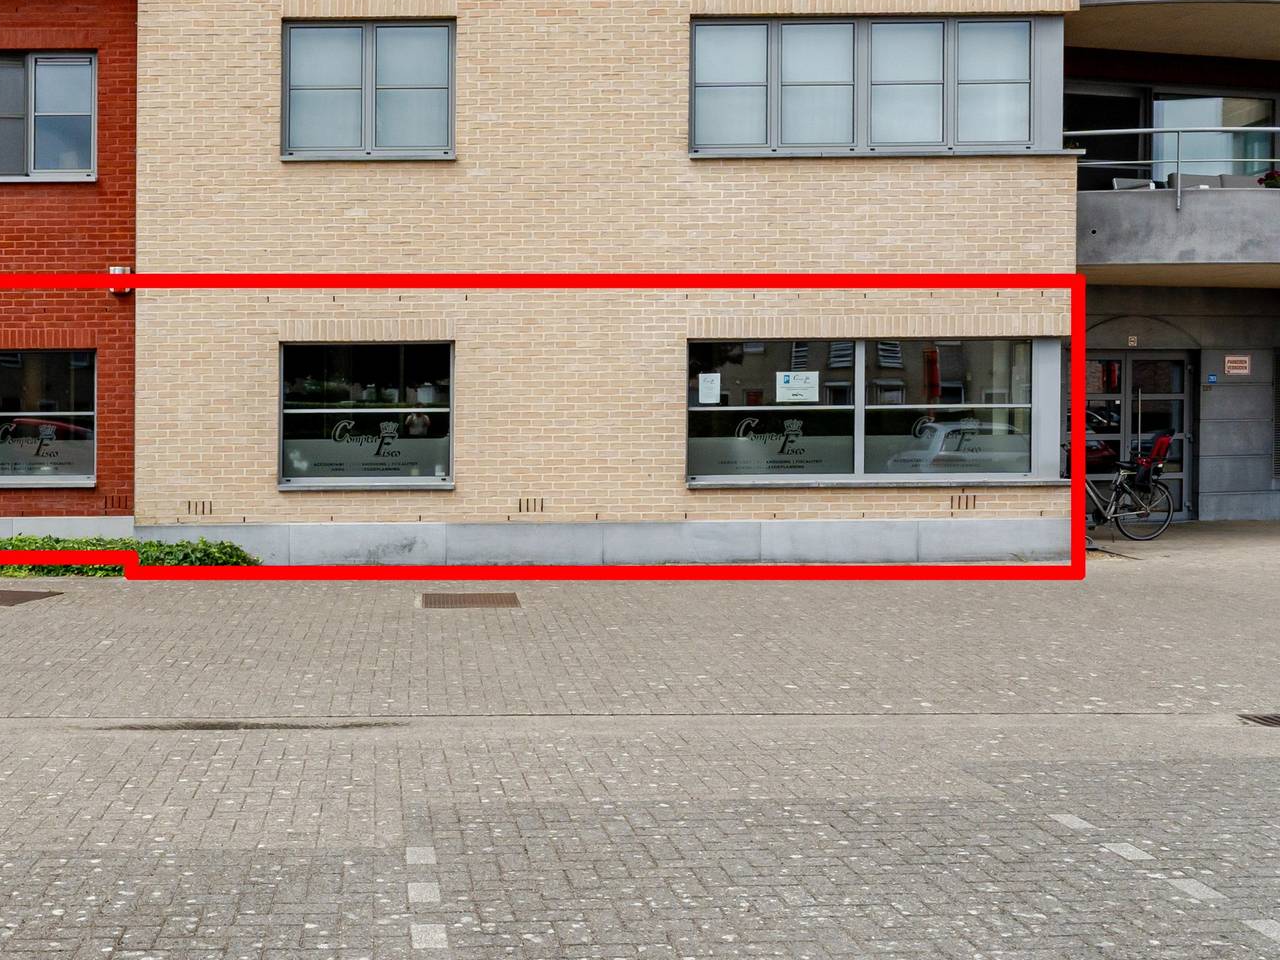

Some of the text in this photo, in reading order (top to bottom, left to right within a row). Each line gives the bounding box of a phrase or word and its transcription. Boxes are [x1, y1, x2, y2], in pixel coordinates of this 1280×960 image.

[332, 420, 401, 456] Compta Fisco
[735, 418, 805, 455] Compta Fisco
